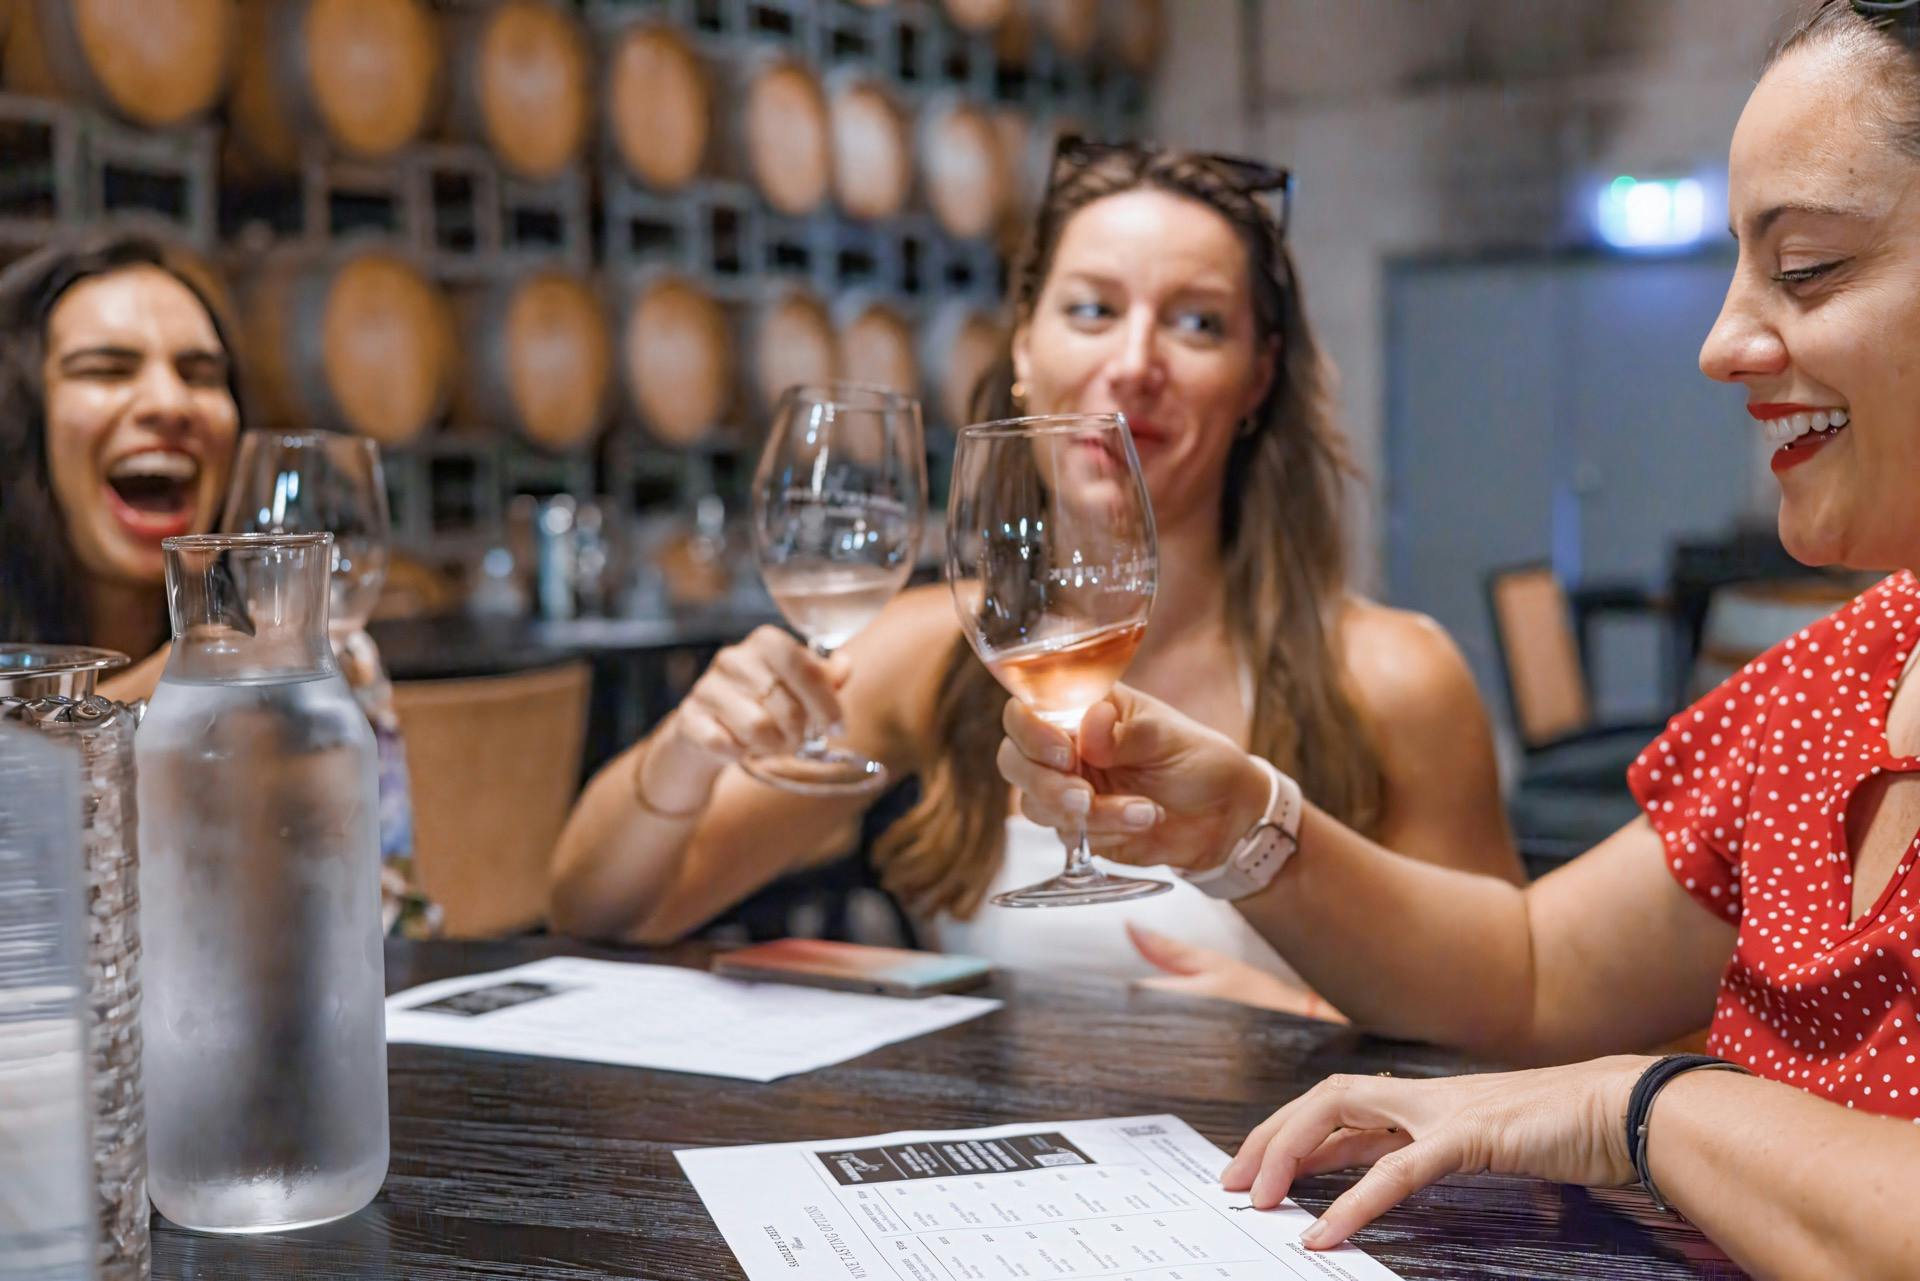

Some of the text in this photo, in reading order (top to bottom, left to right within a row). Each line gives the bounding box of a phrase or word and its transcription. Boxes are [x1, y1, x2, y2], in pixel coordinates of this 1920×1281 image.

[763, 1225, 800, 1268] SADDLER'S CREEK
[804, 1205, 867, 1279] WINE TASTING OPTIONS
